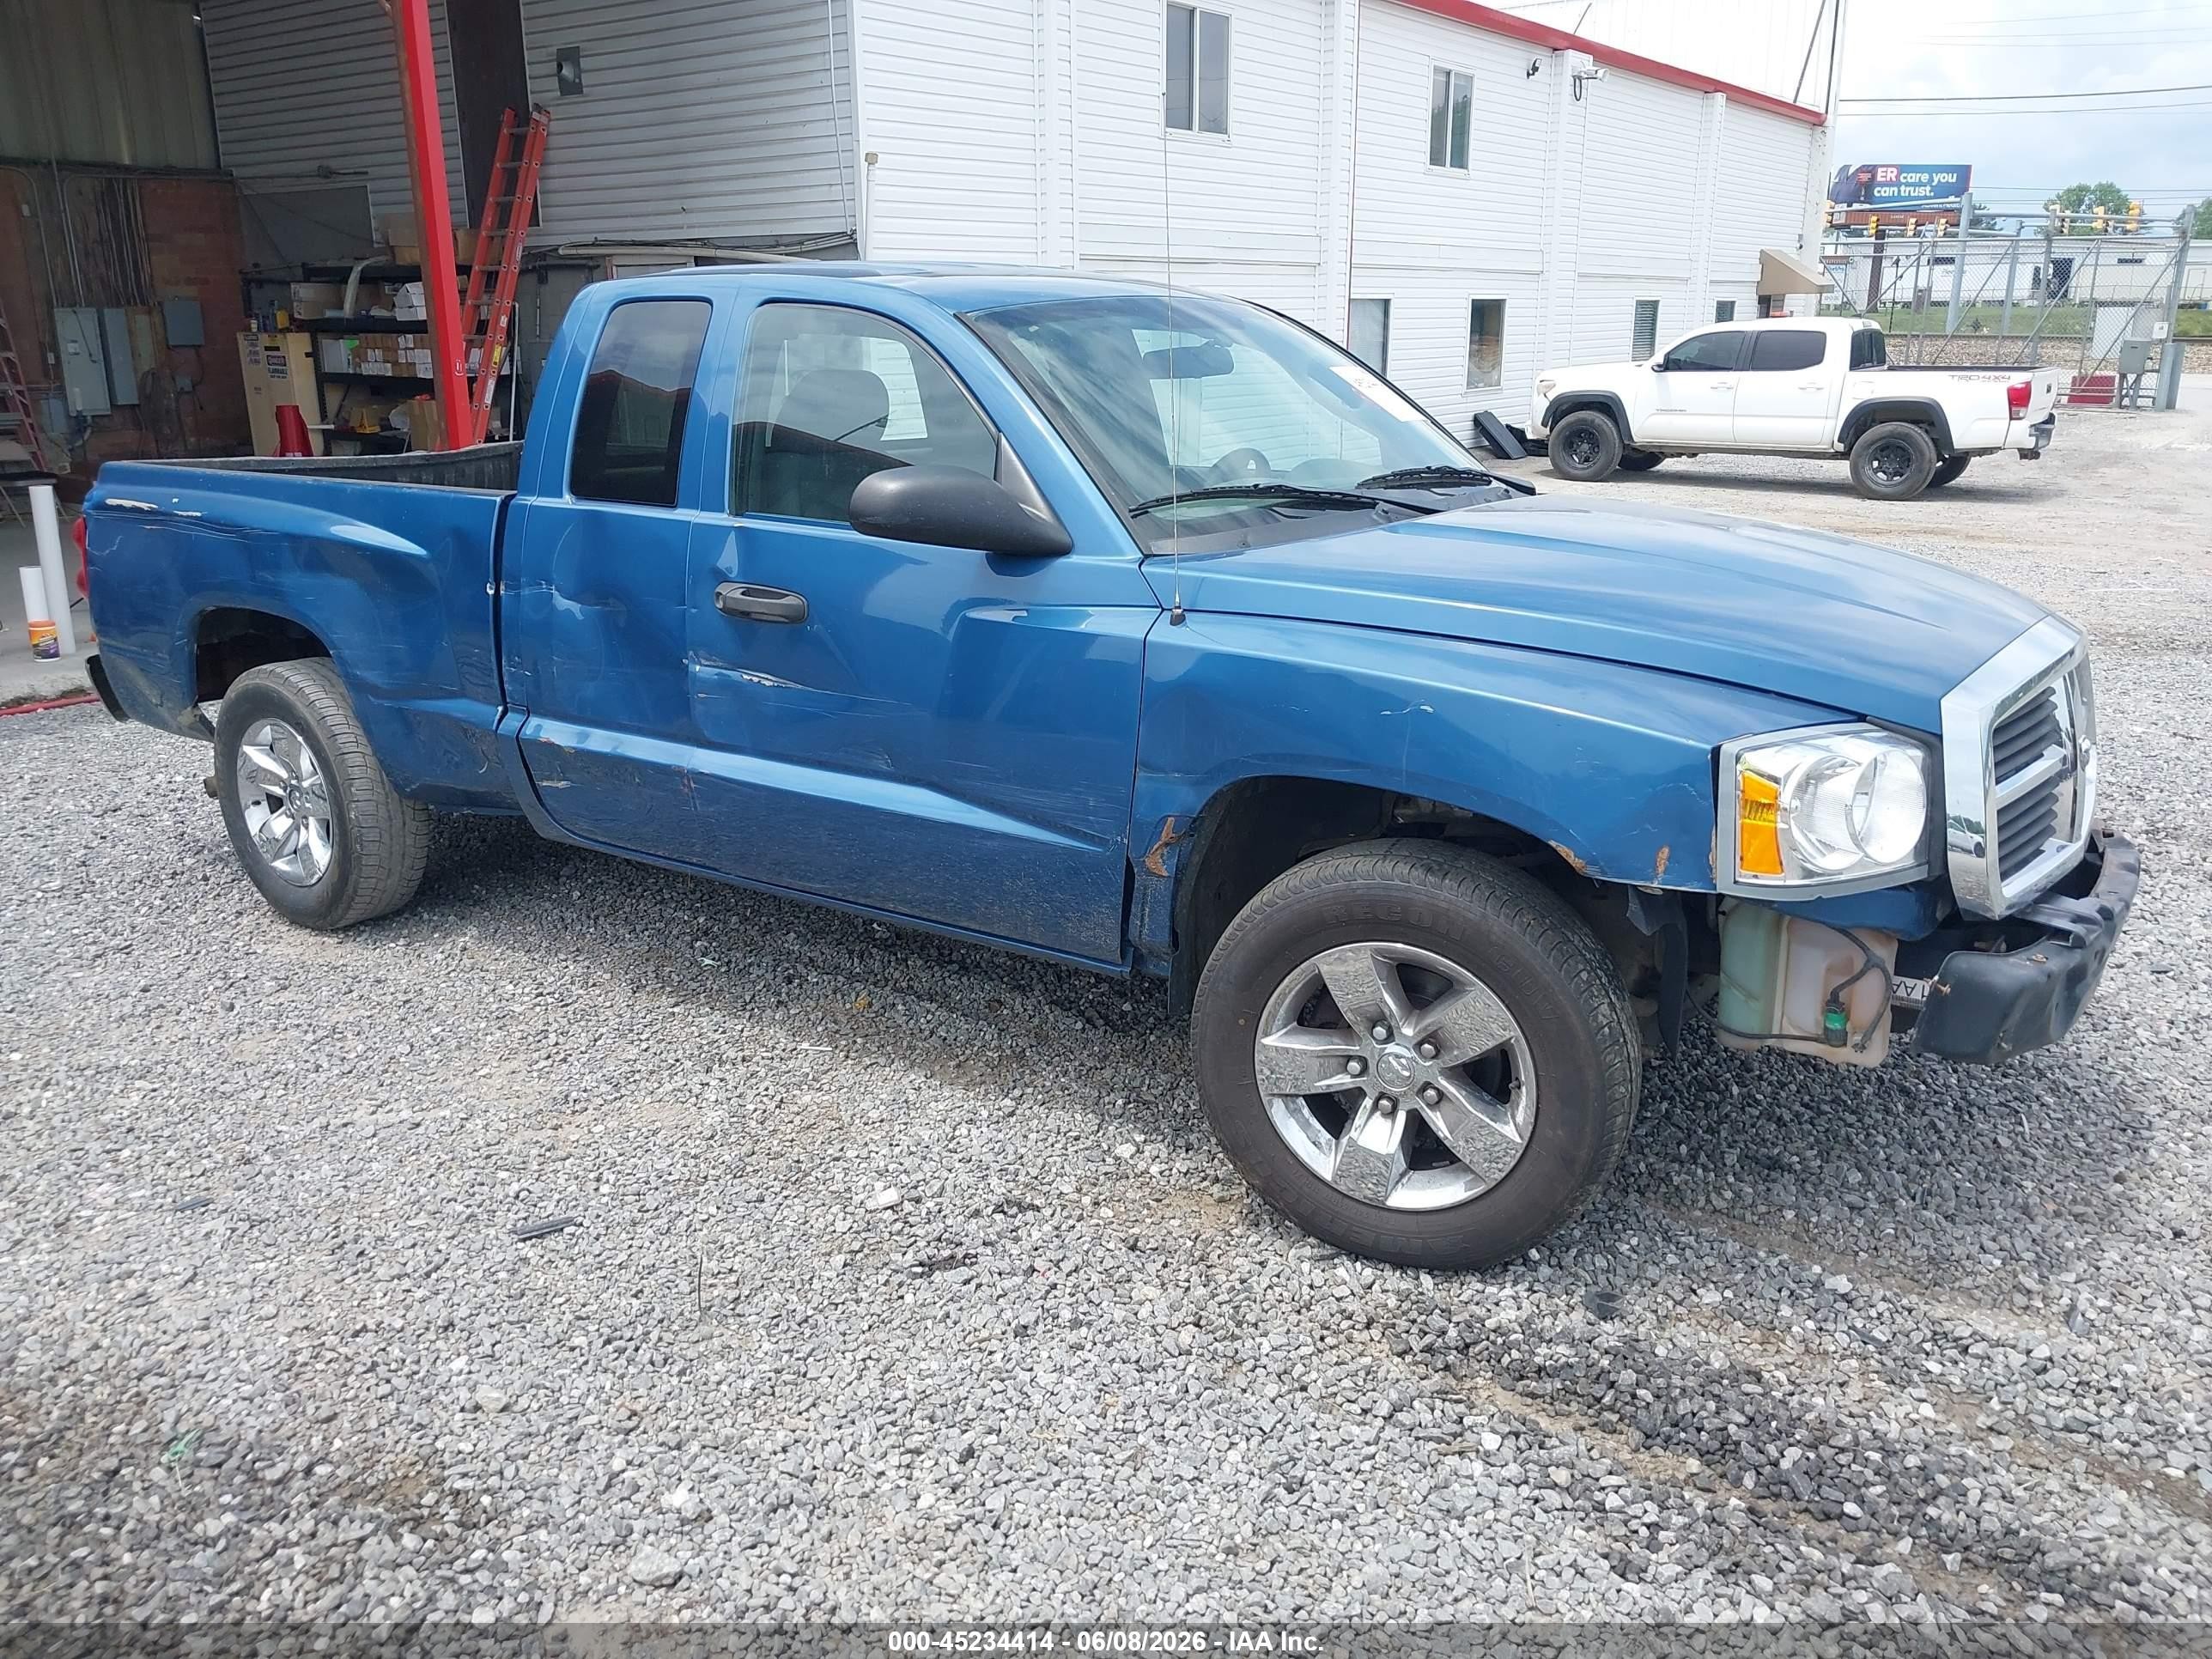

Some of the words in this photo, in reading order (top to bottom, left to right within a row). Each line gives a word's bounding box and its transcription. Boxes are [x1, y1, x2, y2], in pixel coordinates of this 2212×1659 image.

[1877, 167, 1898, 182] ER
[1899, 173, 1929, 183] care
[1931, 173, 1957, 185] you
[1874, 186, 1899, 197] can
[1899, 185, 1935, 197] trust.
